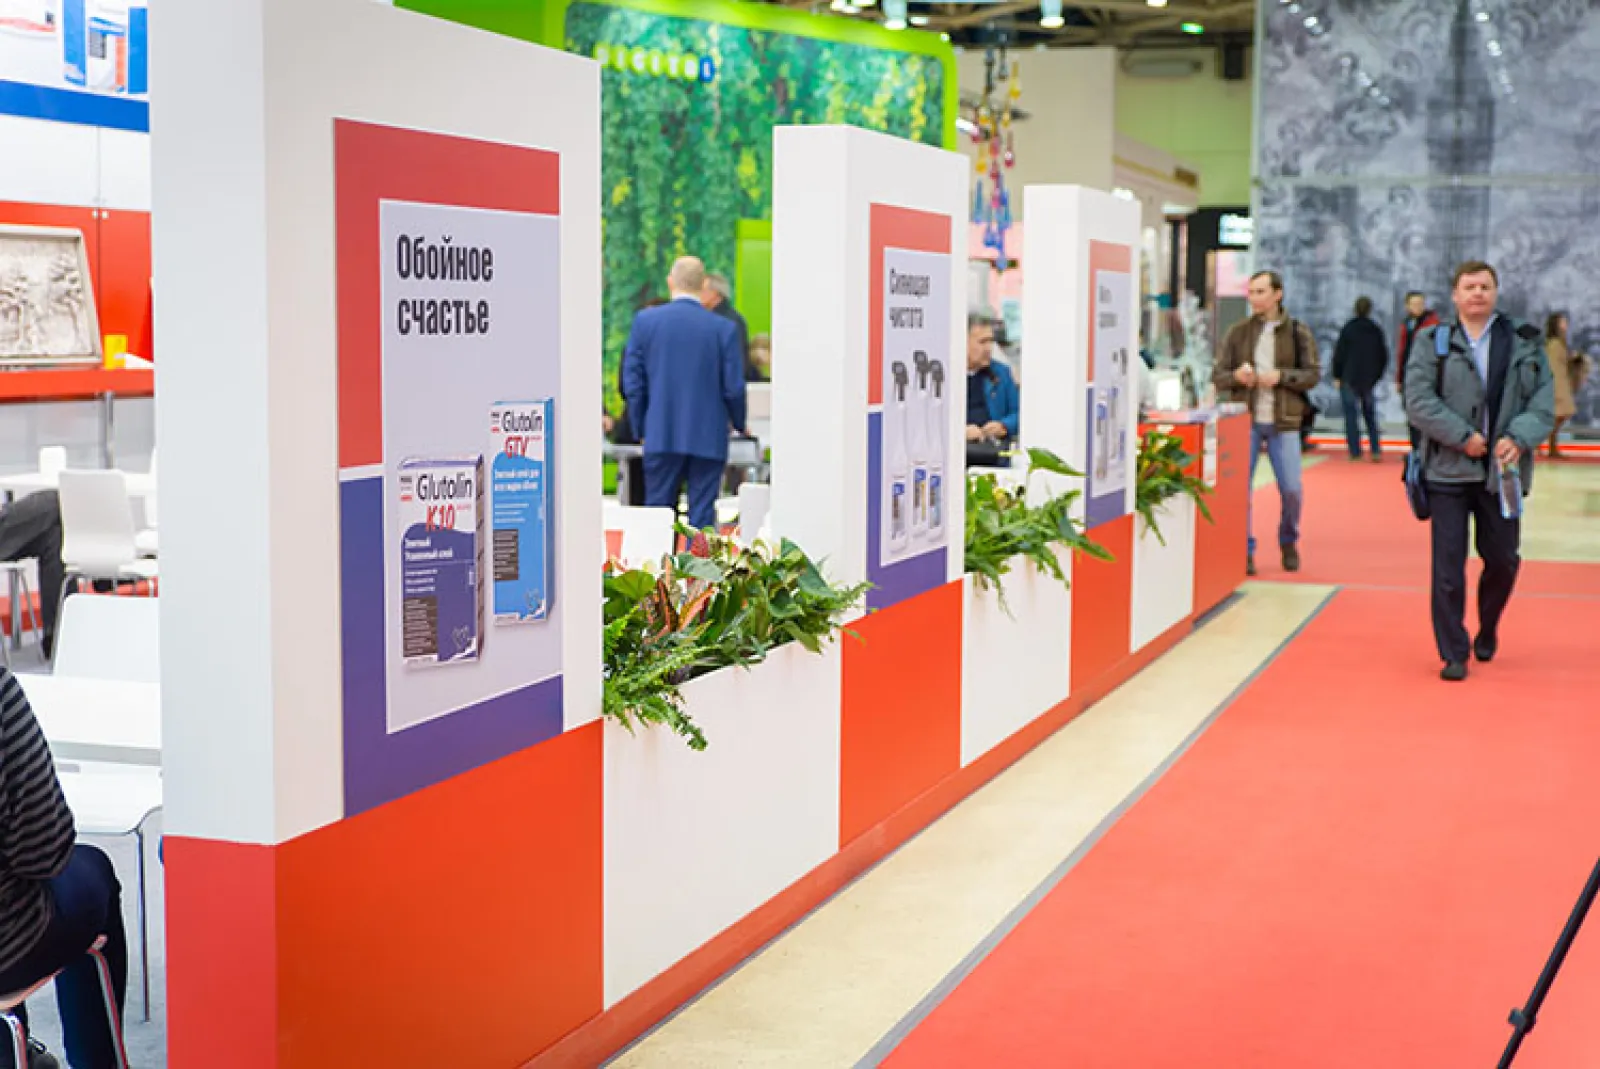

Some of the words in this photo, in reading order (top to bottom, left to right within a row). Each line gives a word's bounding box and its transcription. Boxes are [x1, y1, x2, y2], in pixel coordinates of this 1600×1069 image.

[397, 234, 494, 282] Обойное
[398, 299, 490, 336] счастье
[503, 409, 543, 432] Glutolin
[505, 435, 527, 458] GTV
[416, 472, 473, 501] Glutolin
[426, 503, 455, 532] K10
